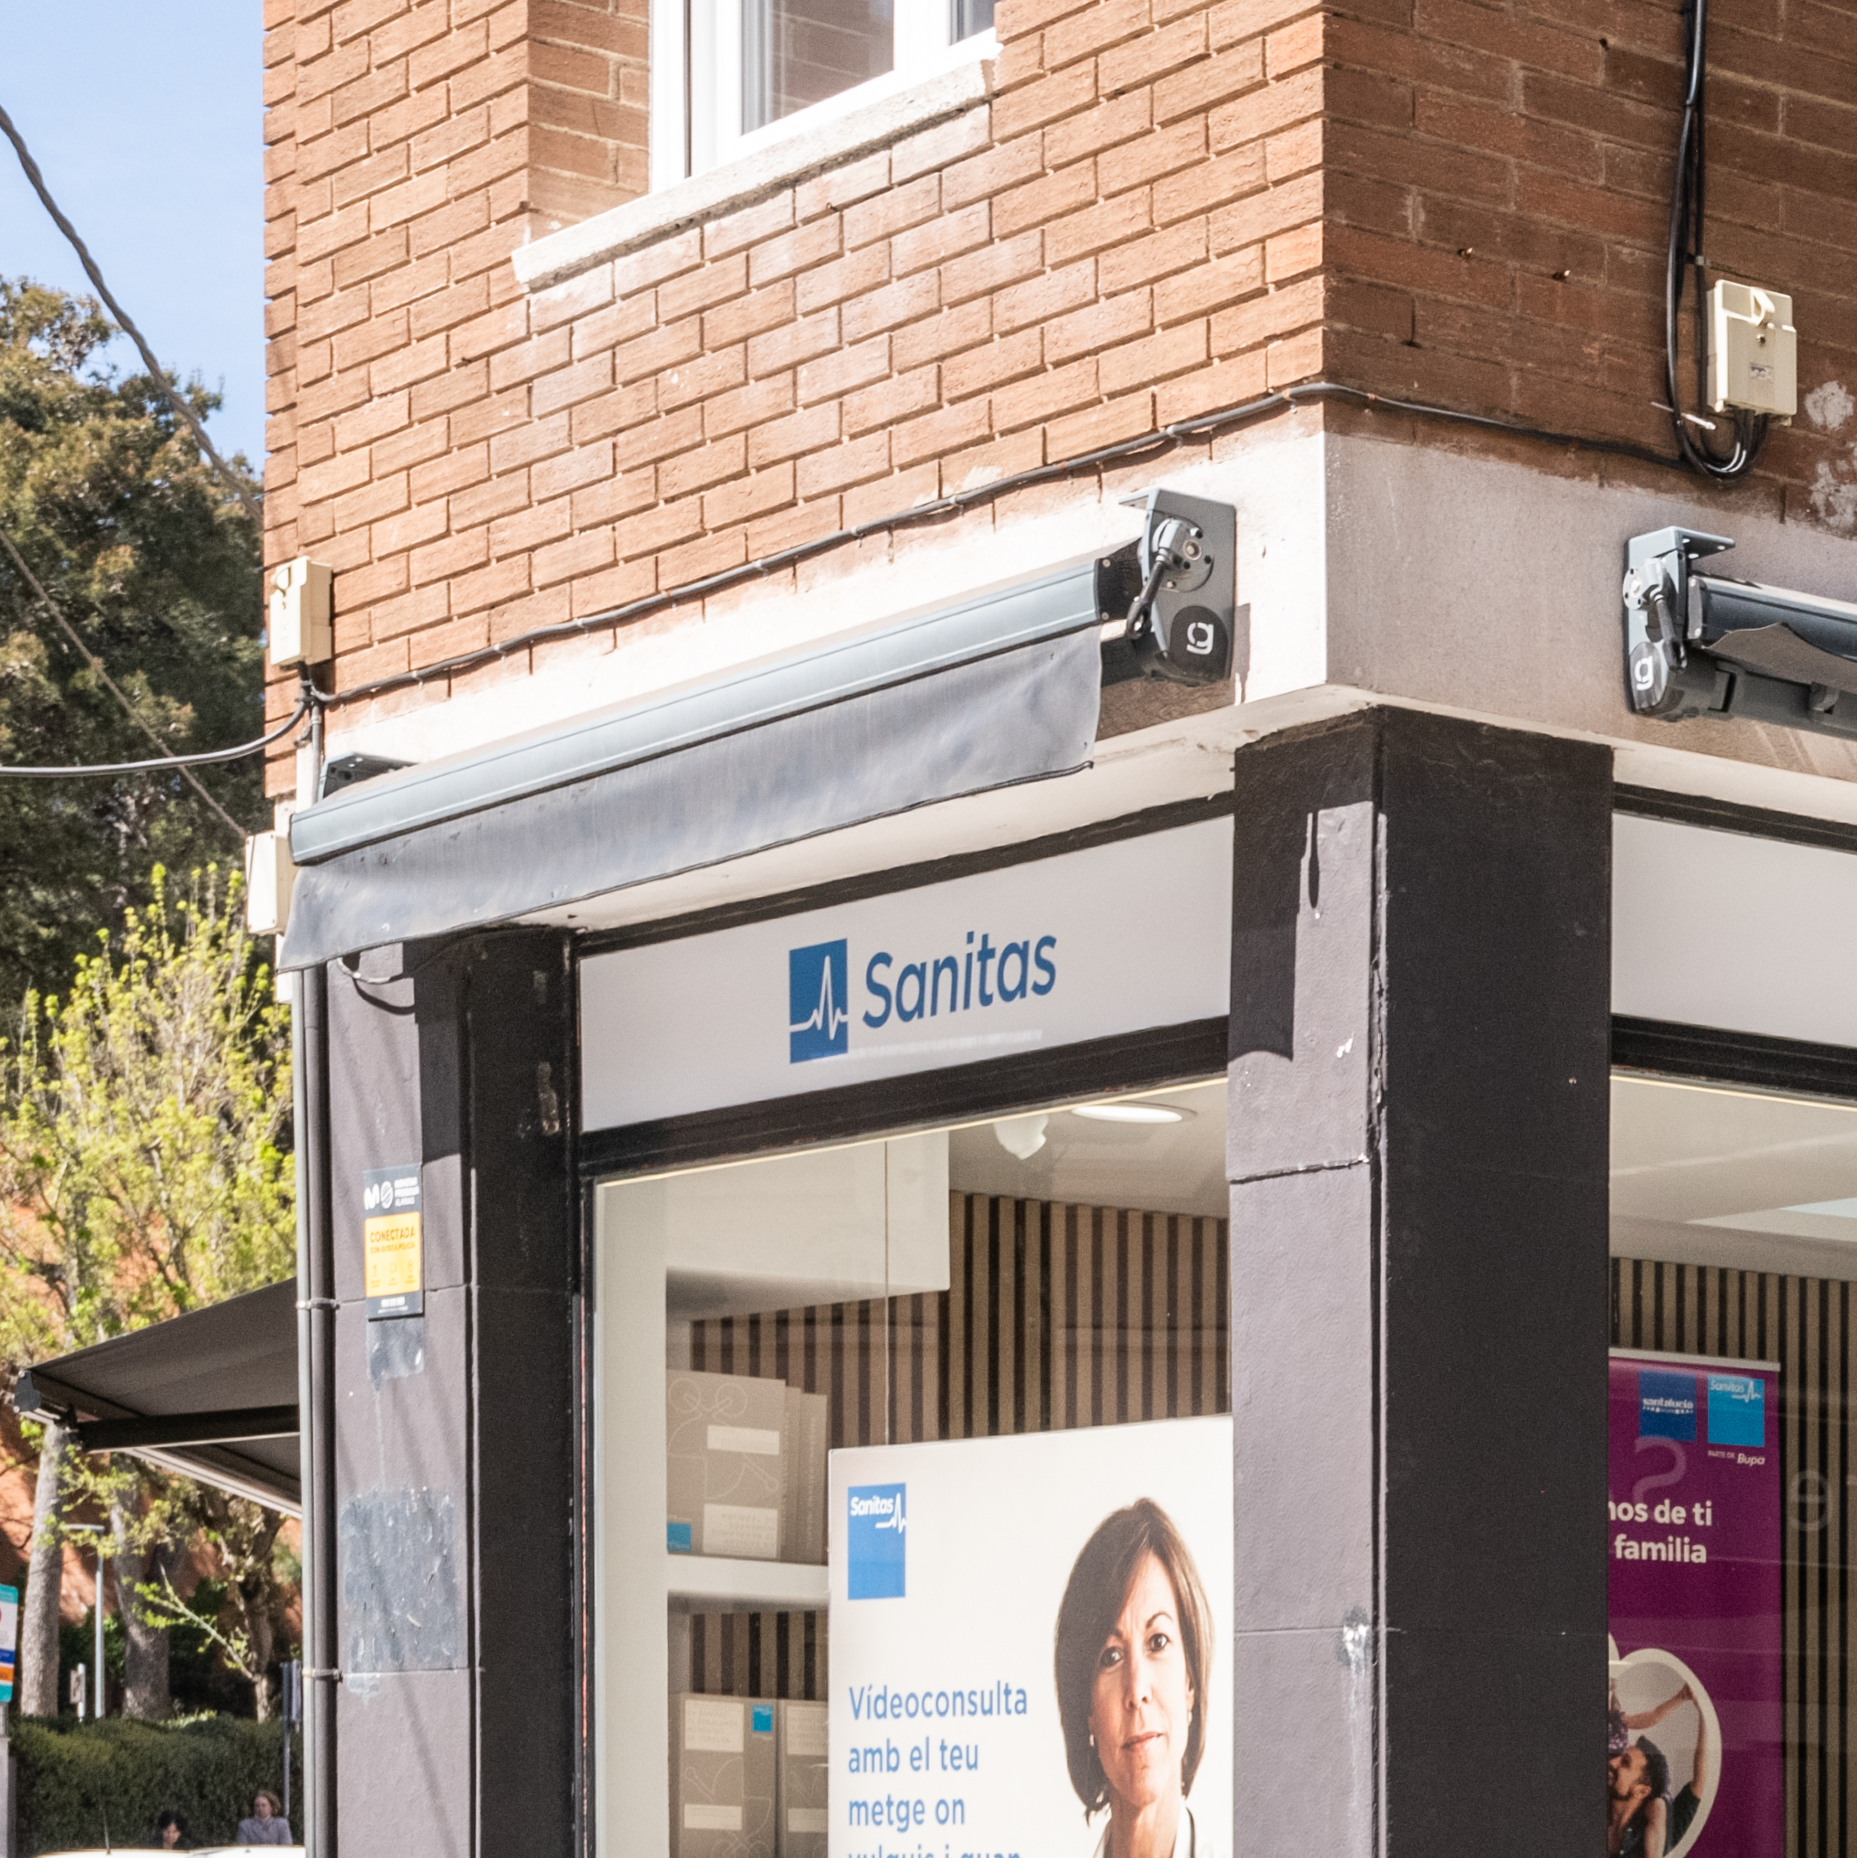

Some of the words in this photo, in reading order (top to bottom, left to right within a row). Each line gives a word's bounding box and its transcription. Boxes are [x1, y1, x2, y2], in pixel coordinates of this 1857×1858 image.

[862, 928, 1057, 1028] Sanitas
[370, 1226, 416, 1243] CONECTADA
[1709, 1379, 1745, 1393] Sanitas
[1737, 1452, 1765, 1467] Bupa
[850, 1494, 894, 1517] Sanitas
[1654, 1499, 1686, 1525] de
[1692, 1500, 1712, 1526] ti
[1615, 1533, 1707, 1563] familia
[849, 1681, 1028, 1724] Vídeoconsulta
[848, 1739, 900, 1774] amb
[909, 1739, 930, 1772] el
[940, 1742, 979, 1771] teu
[848, 1794, 926, 1833] metge
[934, 1798, 965, 1826] on
